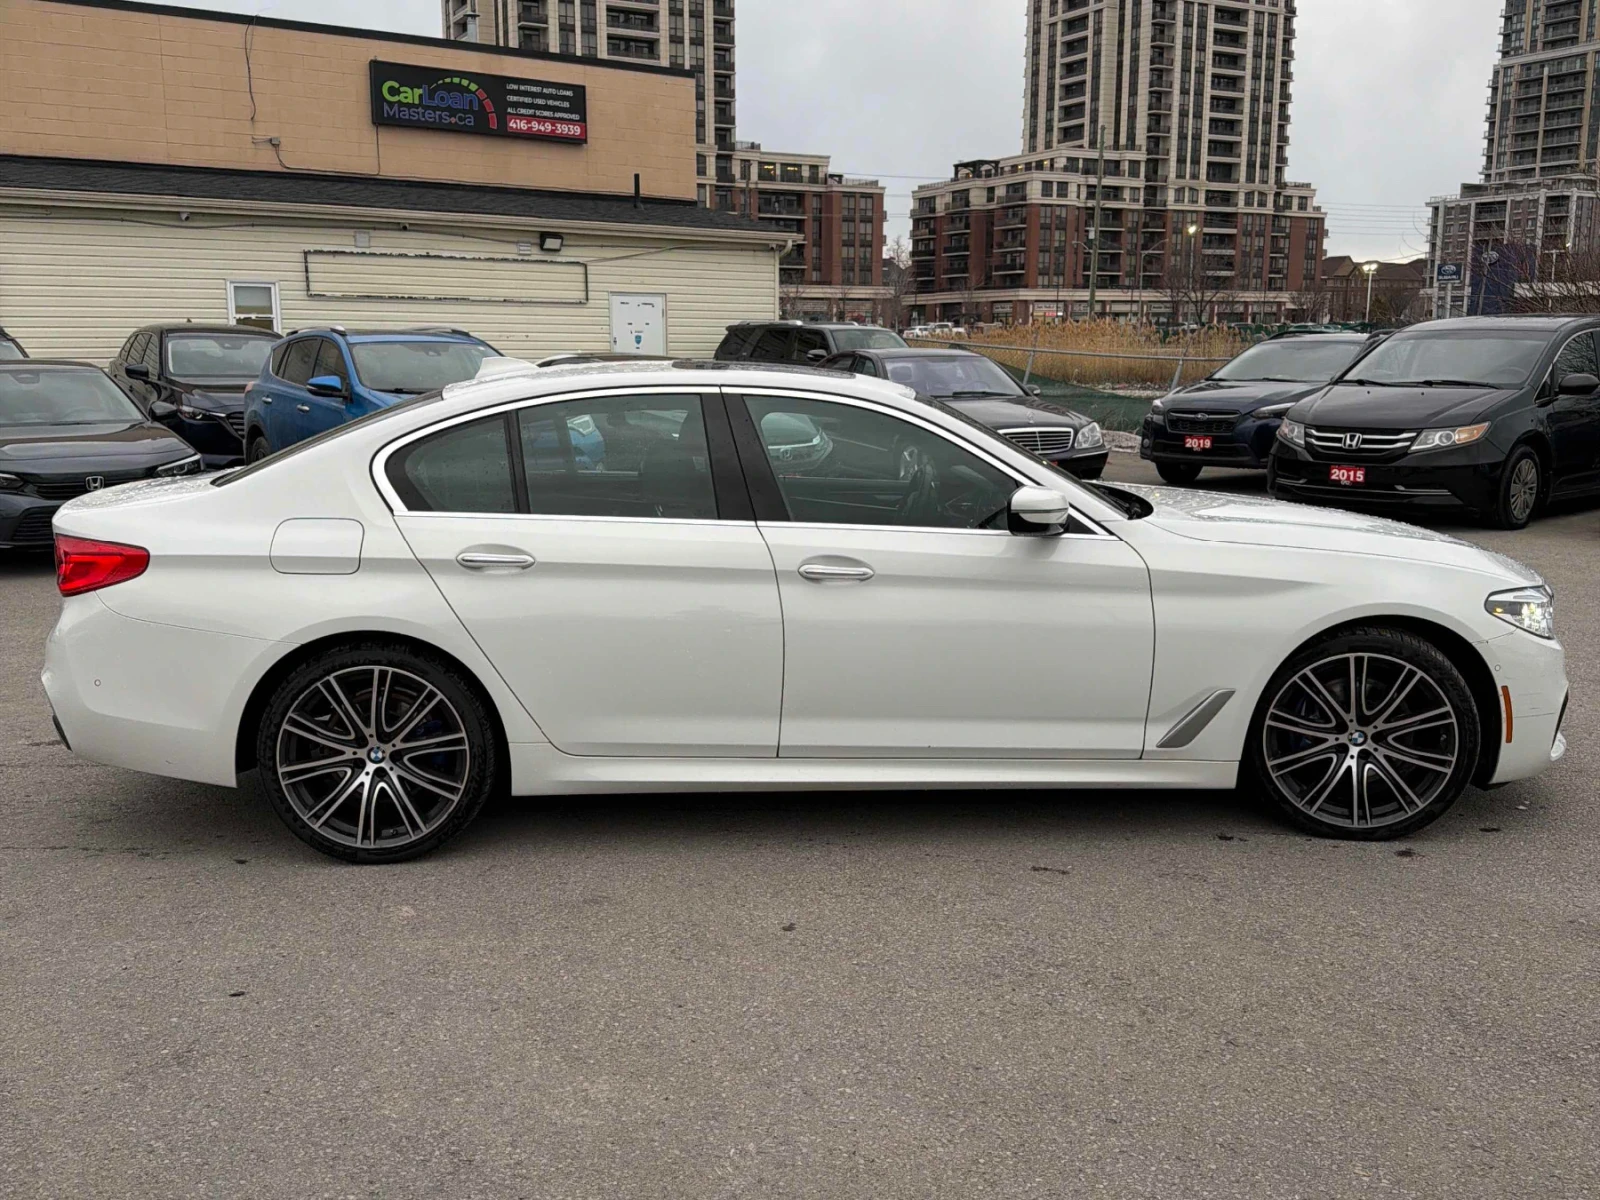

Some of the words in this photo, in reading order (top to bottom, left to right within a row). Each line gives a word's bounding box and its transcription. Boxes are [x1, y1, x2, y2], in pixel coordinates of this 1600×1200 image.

[382, 80, 479, 110] CarLoan
[519, 85, 542, 93] INTEREST
[542, 87, 557, 95] AUTO
[557, 89, 574, 97] LOANS
[506, 95, 533, 104] CERTIFIED
[547, 99, 570, 108] VEHICLES
[383, 102, 475, 126] Masters.ca
[535, 109, 554, 118] SCORES
[554, 111, 580, 120] APPROVED
[509, 119, 581, 135] 416-949-3939
[1185, 439, 1211, 448] 2019
[1331, 469, 1364, 481] 2015
